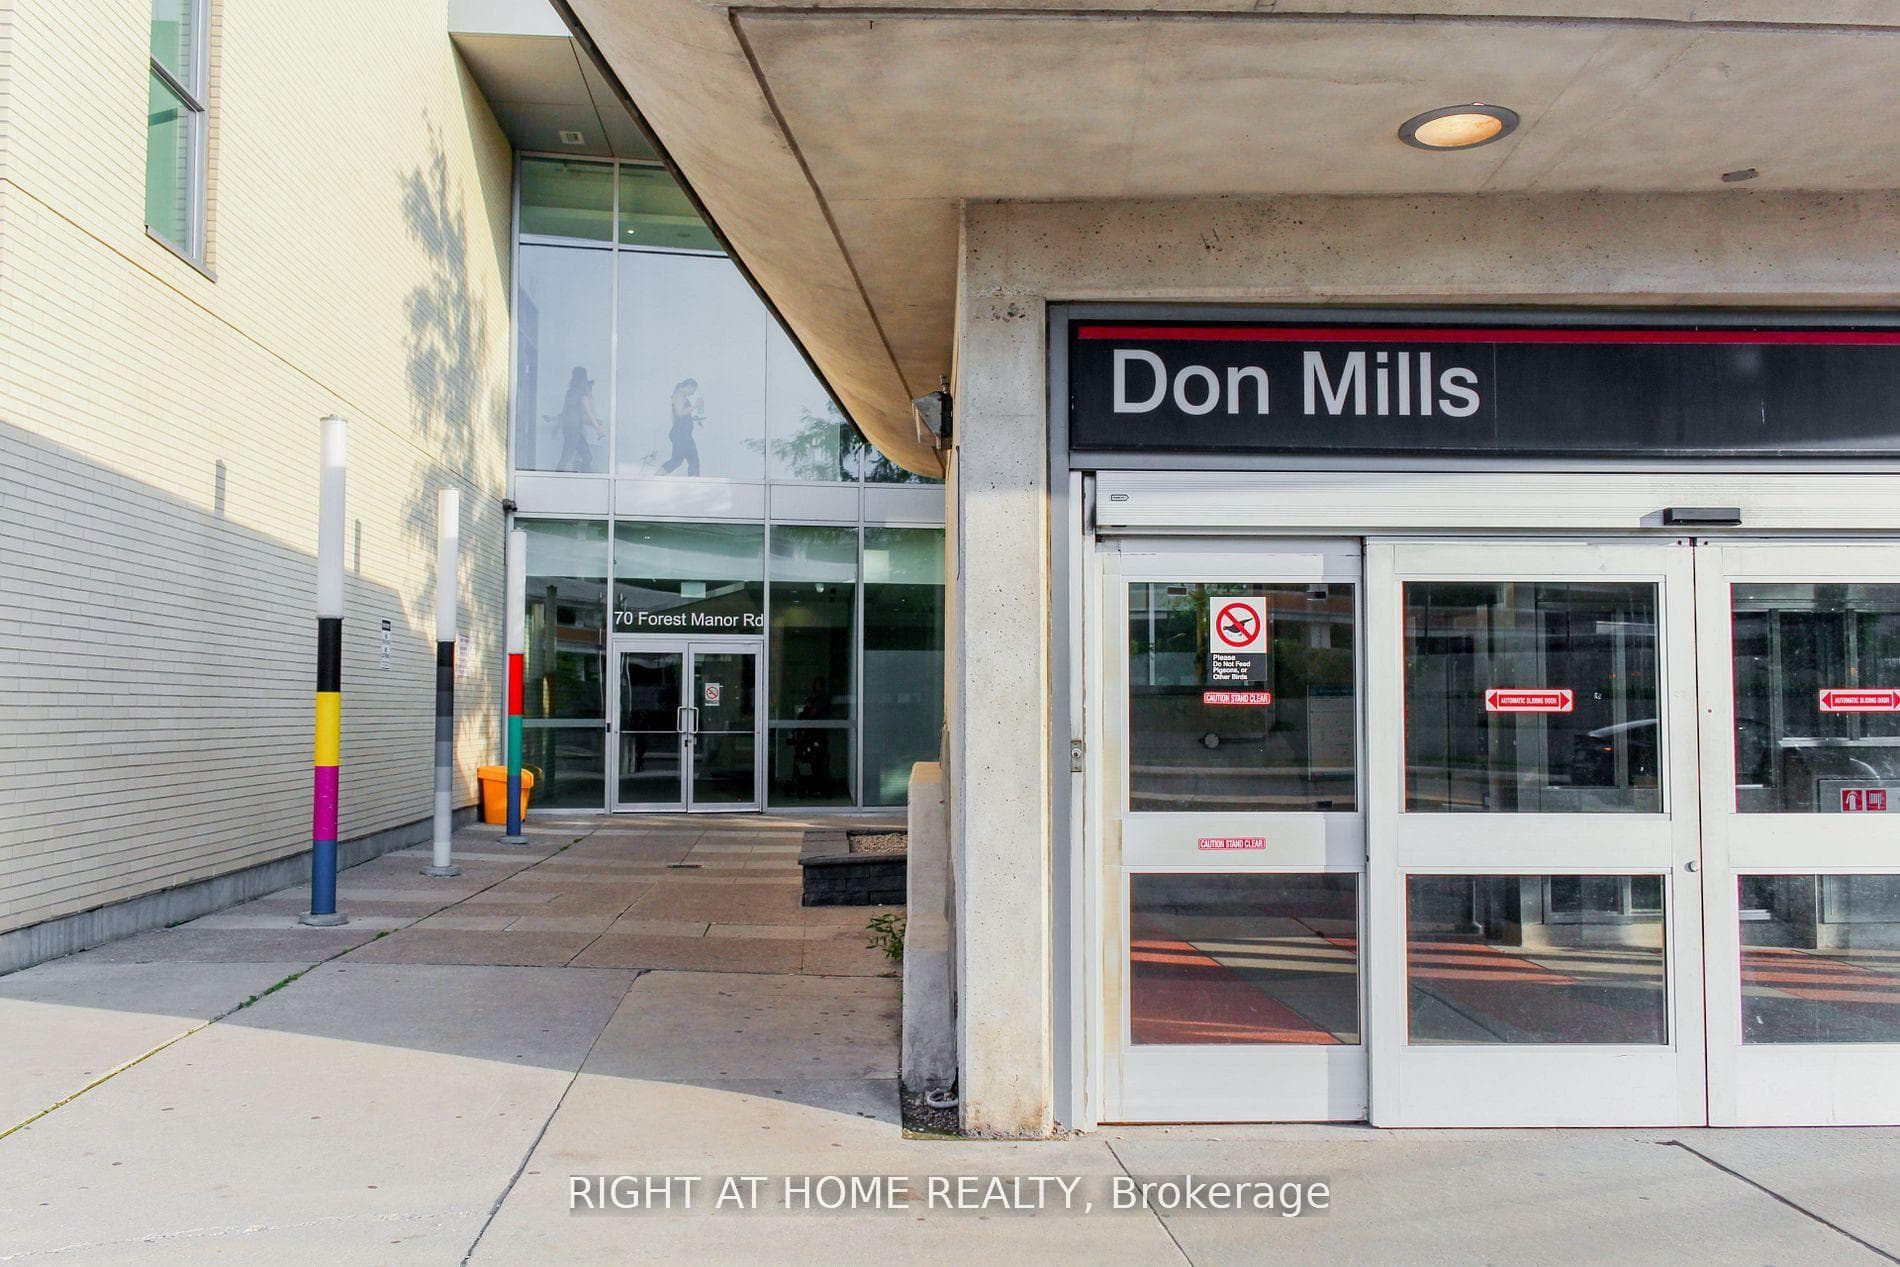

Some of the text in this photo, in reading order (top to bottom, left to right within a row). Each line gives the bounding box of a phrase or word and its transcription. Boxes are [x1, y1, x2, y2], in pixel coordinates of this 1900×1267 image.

[1113, 349, 1481, 418] Don Mills
[614, 611, 764, 627] 70 Forest Manor Rd
[1206, 694, 1268, 702] CAUTION STAND CLEAR
[1200, 839, 1263, 848] CAUTION STAND CLEAR
